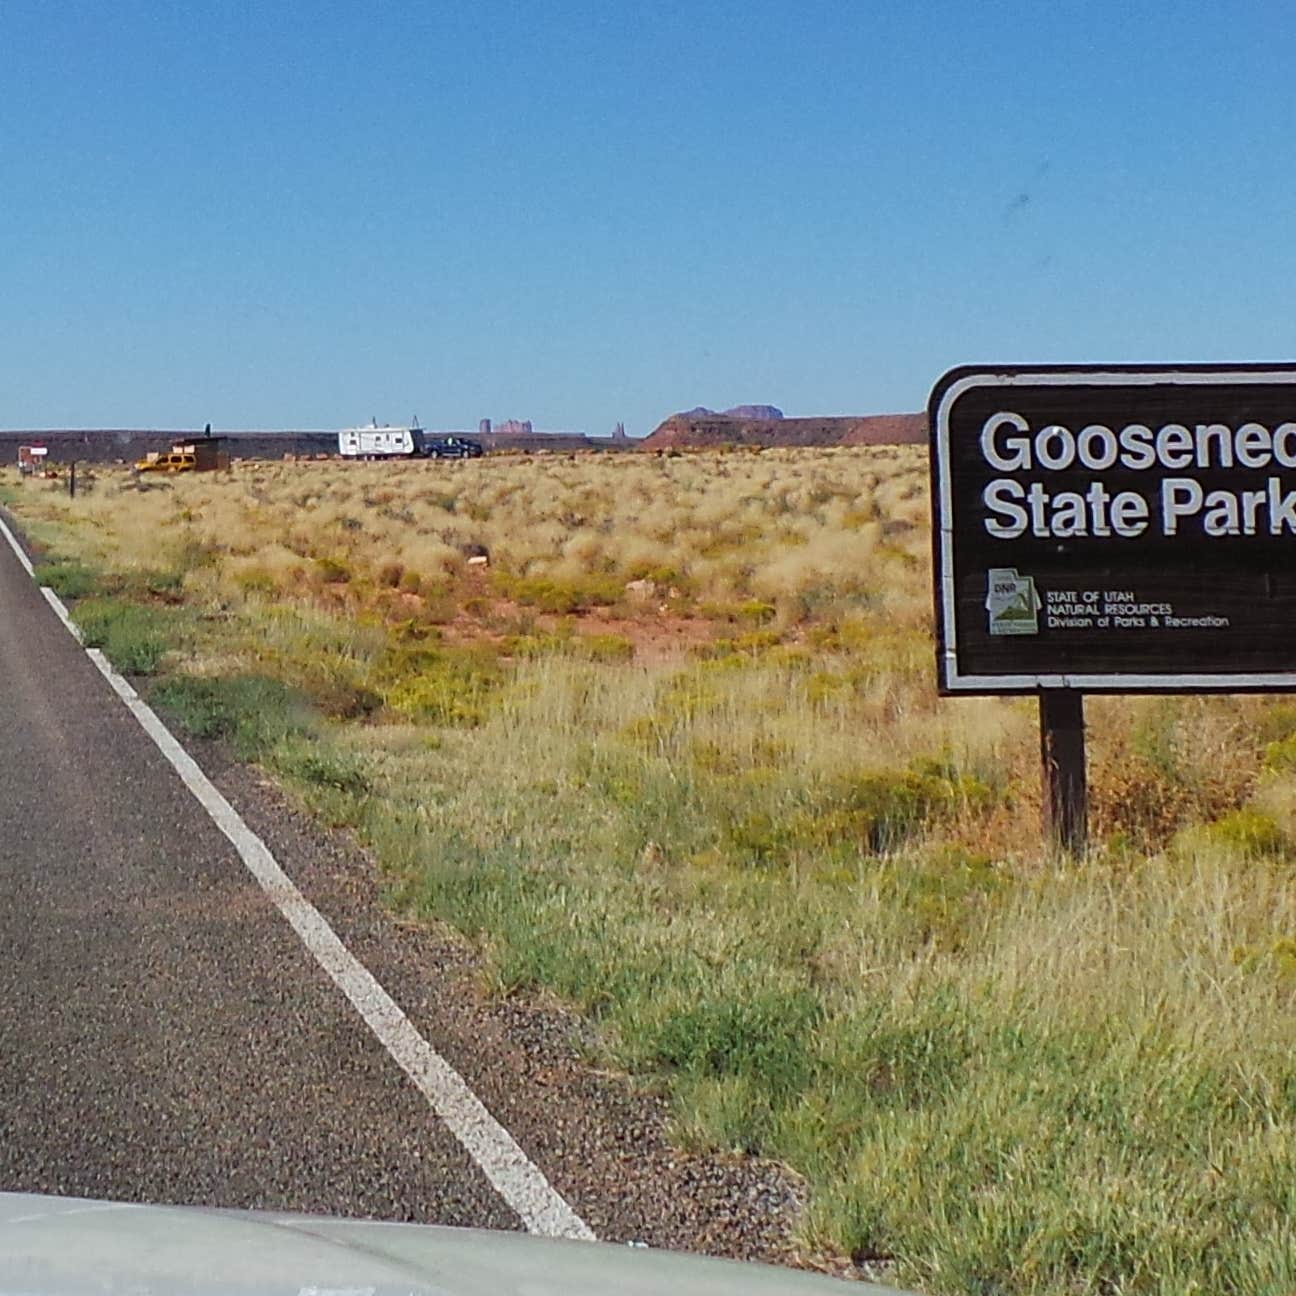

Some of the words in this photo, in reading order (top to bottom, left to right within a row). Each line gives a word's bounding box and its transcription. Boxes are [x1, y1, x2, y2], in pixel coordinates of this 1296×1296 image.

[983, 478, 1150, 539] State
[1161, 477, 1296, 536] Park
[1047, 591, 1077, 603] STATE
[1083, 591, 1099, 603] OF
[1104, 591, 1134, 603] UTAH
[1047, 604, 1099, 616] NATURAL
[1105, 604, 1172, 615] RESOURCES
[1047, 616, 1092, 628] Division
[1097, 616, 1110, 627] of
[1114, 616, 1145, 628] Parks
[1150, 616, 1159, 627] &
[1165, 615, 1229, 627] Recreation
